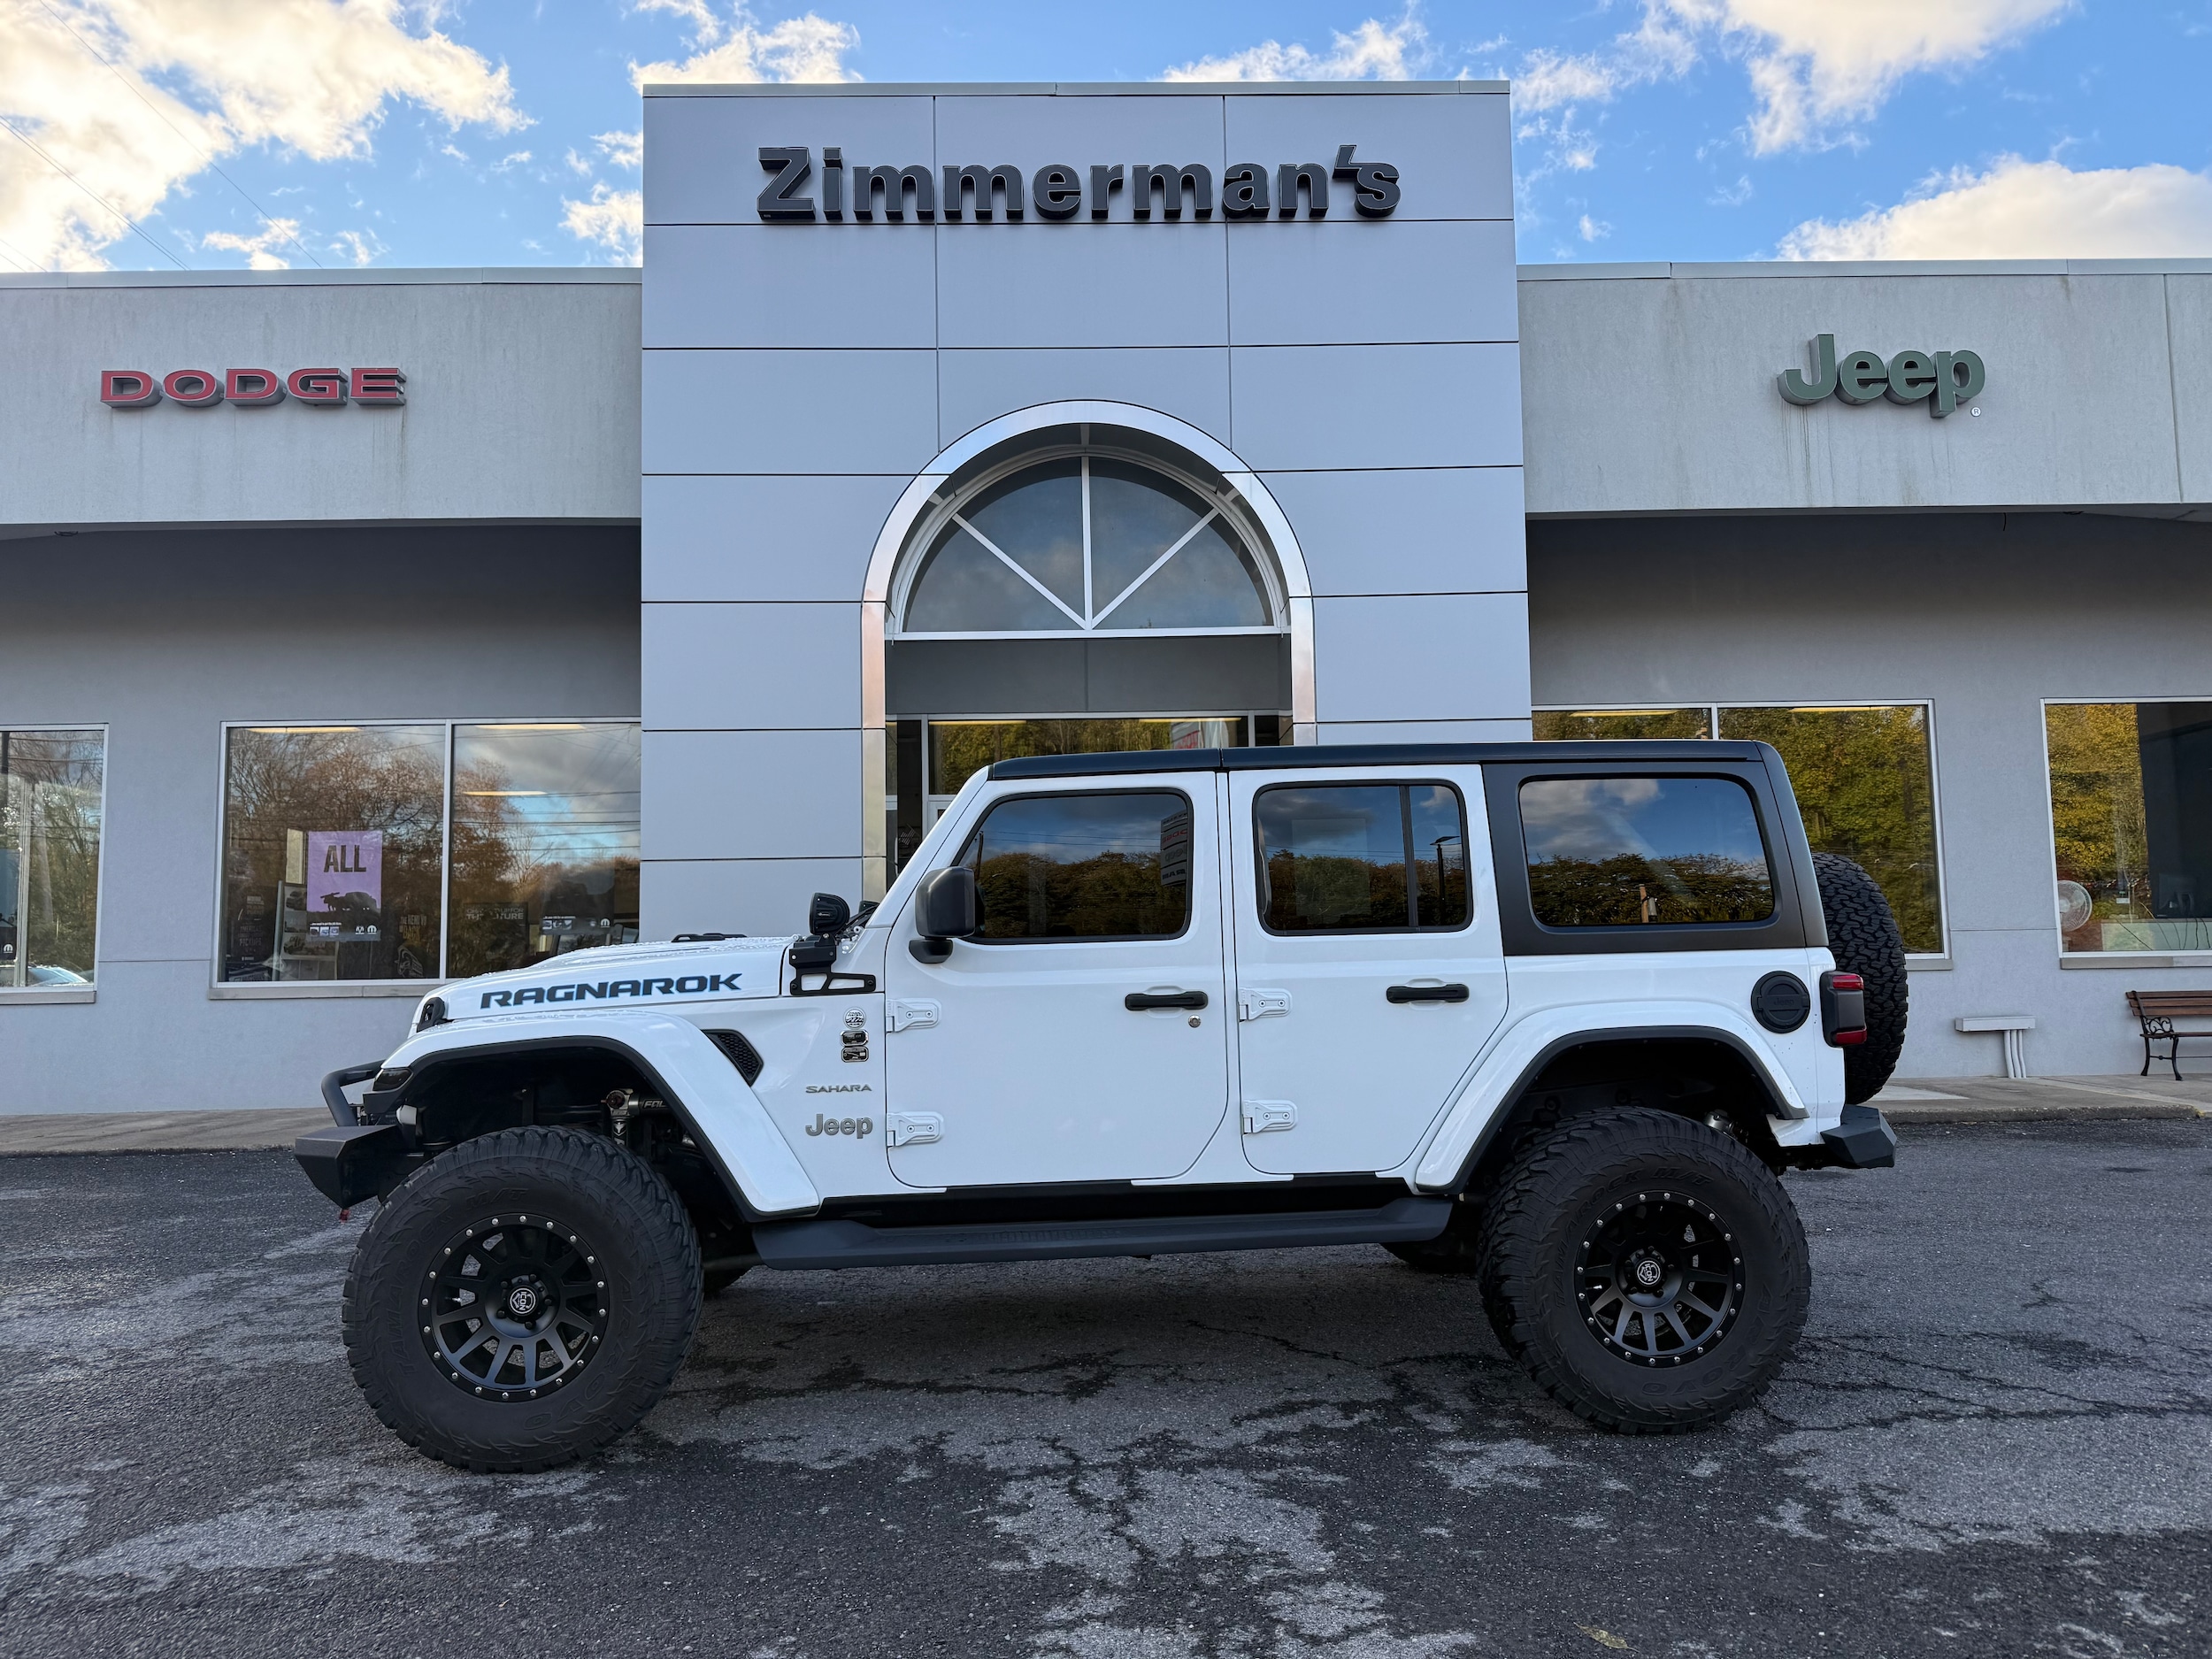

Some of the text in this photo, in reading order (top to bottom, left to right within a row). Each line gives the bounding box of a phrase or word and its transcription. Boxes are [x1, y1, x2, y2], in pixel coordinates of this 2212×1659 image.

[757, 144, 1401, 220] Zimmerman's
[101, 367, 407, 408] DODGE
[1777, 334, 1985, 419] Jeep
[324, 845, 367, 873] ALL
[480, 972, 742, 1010] RAGNAROK
[805, 1084, 872, 1094] SAHARA
[805, 1113, 873, 1140] Jeep
[1653, 1165, 1716, 1187] M/T
[1644, 1263, 1654, 1282] ICON
[518, 1291, 527, 1310] ICON
